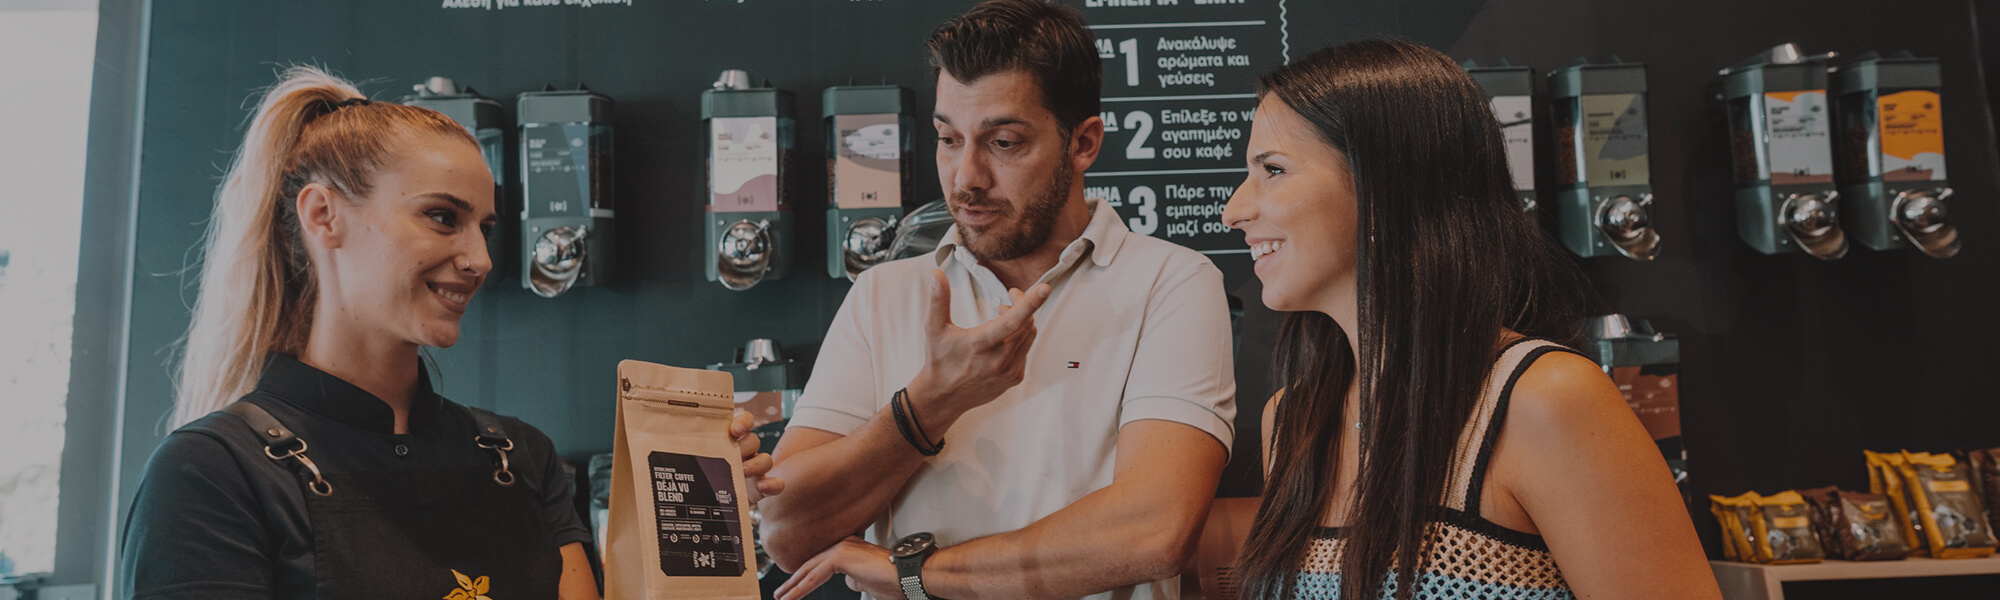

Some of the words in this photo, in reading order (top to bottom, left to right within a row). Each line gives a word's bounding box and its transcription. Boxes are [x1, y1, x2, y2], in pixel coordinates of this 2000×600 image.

[1156, 35, 1236, 53] Ανακάλυψε
[1119, 38, 1139, 87] 1
[1157, 53, 1224, 71] αρώματα
[1227, 54, 1250, 66] και
[1157, 70, 1215, 89] γεύσεις
[1161, 108, 1217, 126] Επίλεξε
[1220, 110, 1238, 122] το
[1240, 107, 1256, 122] νέ
[1123, 110, 1155, 160] 2
[1161, 125, 1241, 144] αγαπημένο
[1162, 147, 1191, 159] σου
[1195, 142, 1233, 160] καφέ
[1165, 184, 1205, 201] Πάρε
[1208, 186, 1233, 200] την
[1084, 186, 1121, 202] ΗΜΑ
[1128, 185, 1159, 235] 3
[1166, 219, 1199, 238] μαζί
[655, 472, 673, 480] FILTER
[675, 474, 694, 482] COFFEE
[678, 483, 689, 493] VU
[658, 492, 684, 503] BLEND
